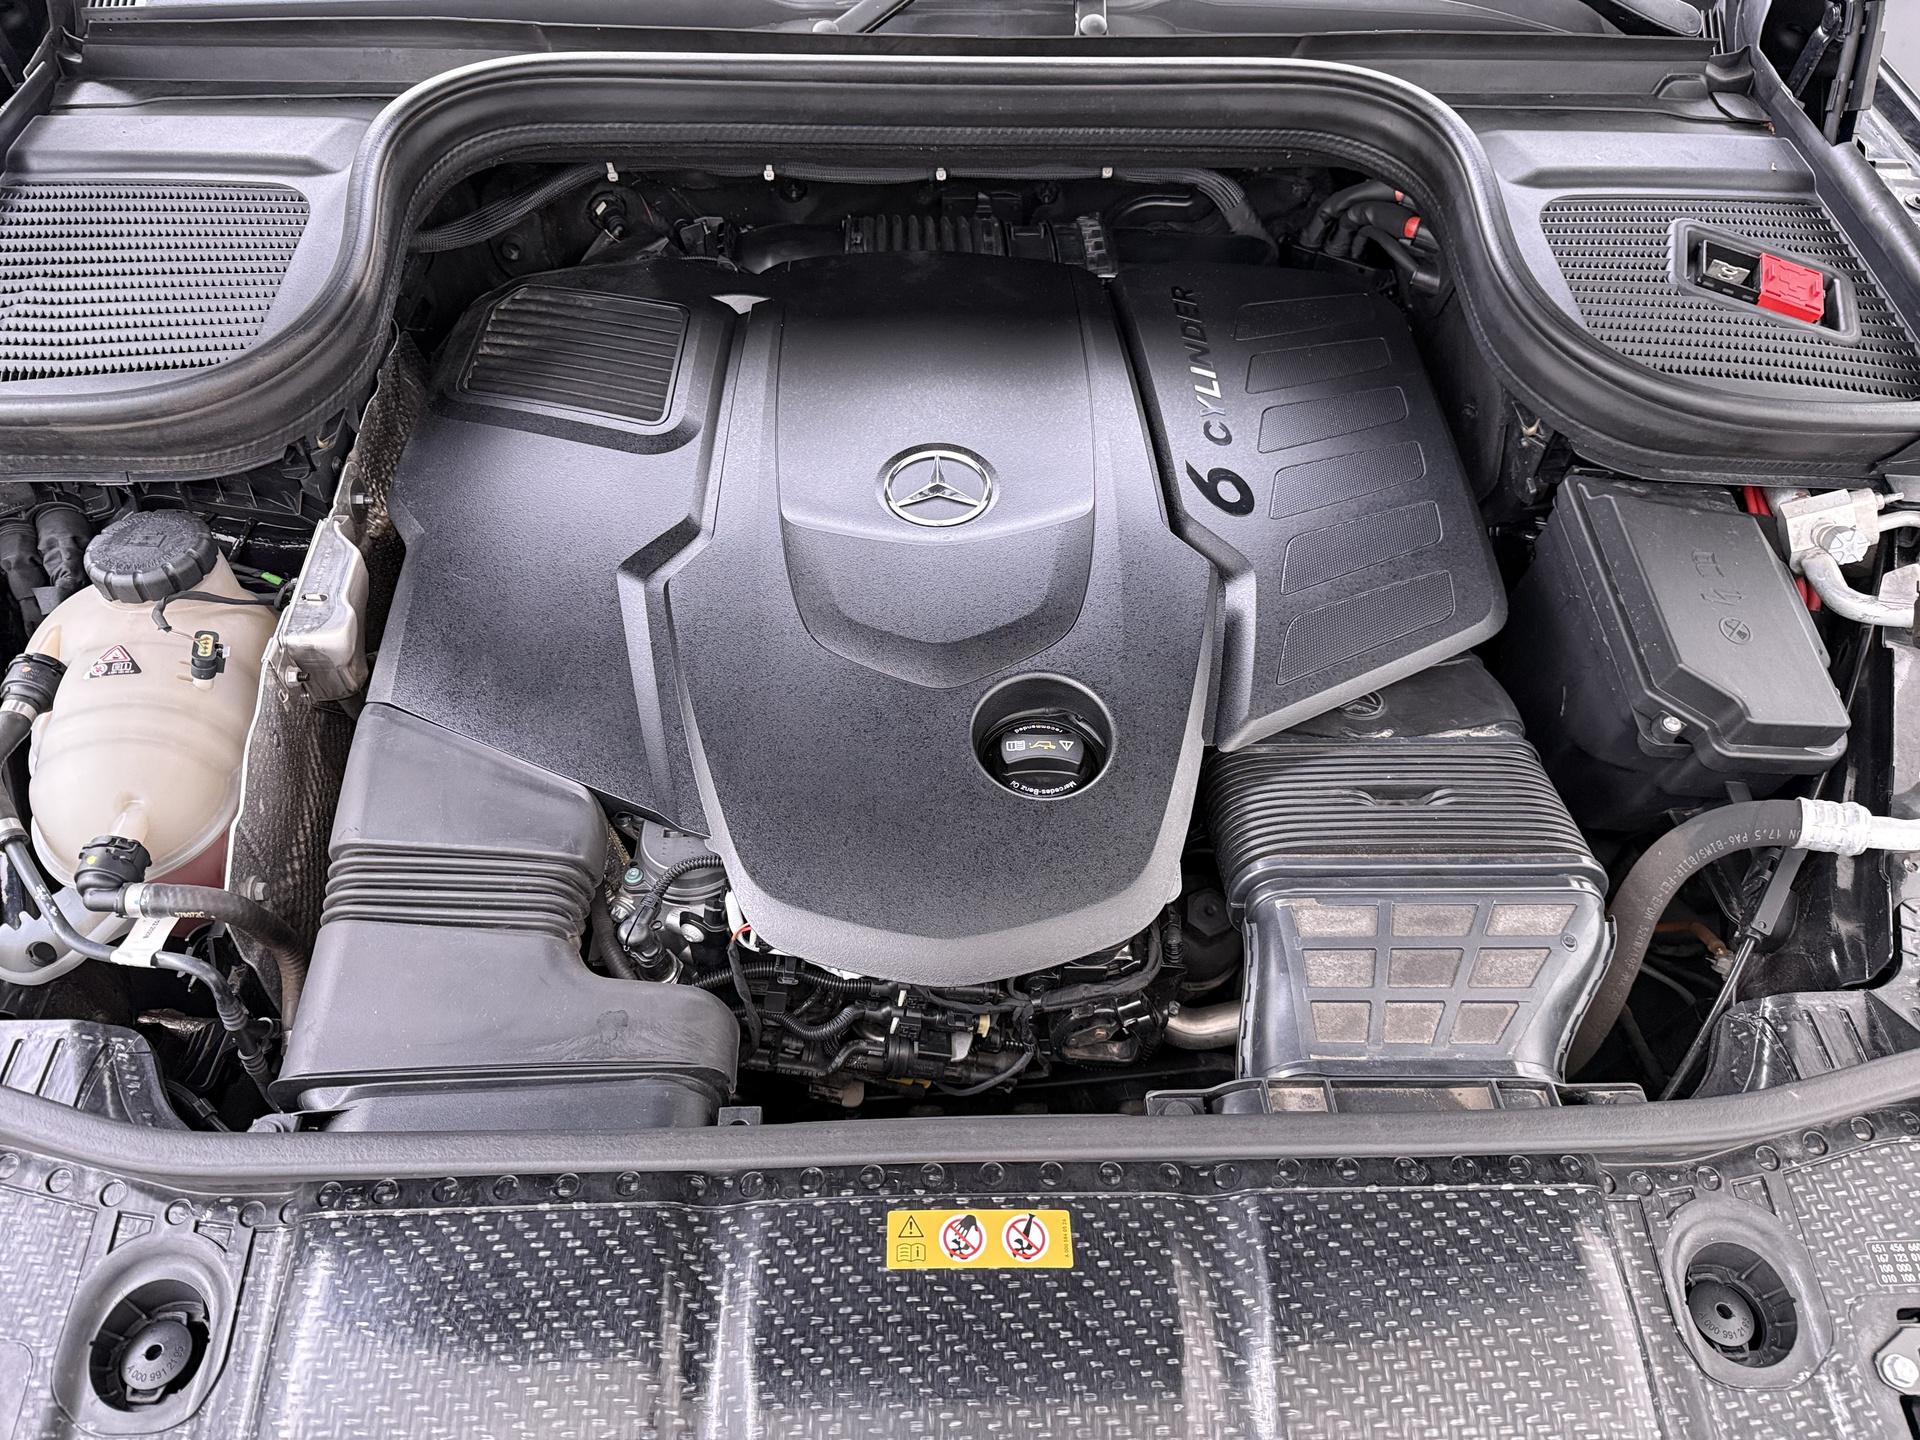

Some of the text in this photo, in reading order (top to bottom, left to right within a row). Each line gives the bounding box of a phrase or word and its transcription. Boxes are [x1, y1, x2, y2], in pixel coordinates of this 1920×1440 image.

[1170, 285, 1255, 517] 6 CYLINDER
[1014, 724, 1063, 733] recommended
[1020, 781, 1077, 795] Mercedes-Benz
[1754, 828, 1781, 841] 17.5
[1871, 1244, 1886, 1253] 651
[1875, 1253, 1889, 1263] 167
[1893, 1253, 1909, 1262] 123
[1878, 1264, 1894, 1273] 100
[1896, 1263, 1912, 1272] 000
[1881, 1273, 1916, 1283] 010 100
[149, 1368, 167, 1382] 991
